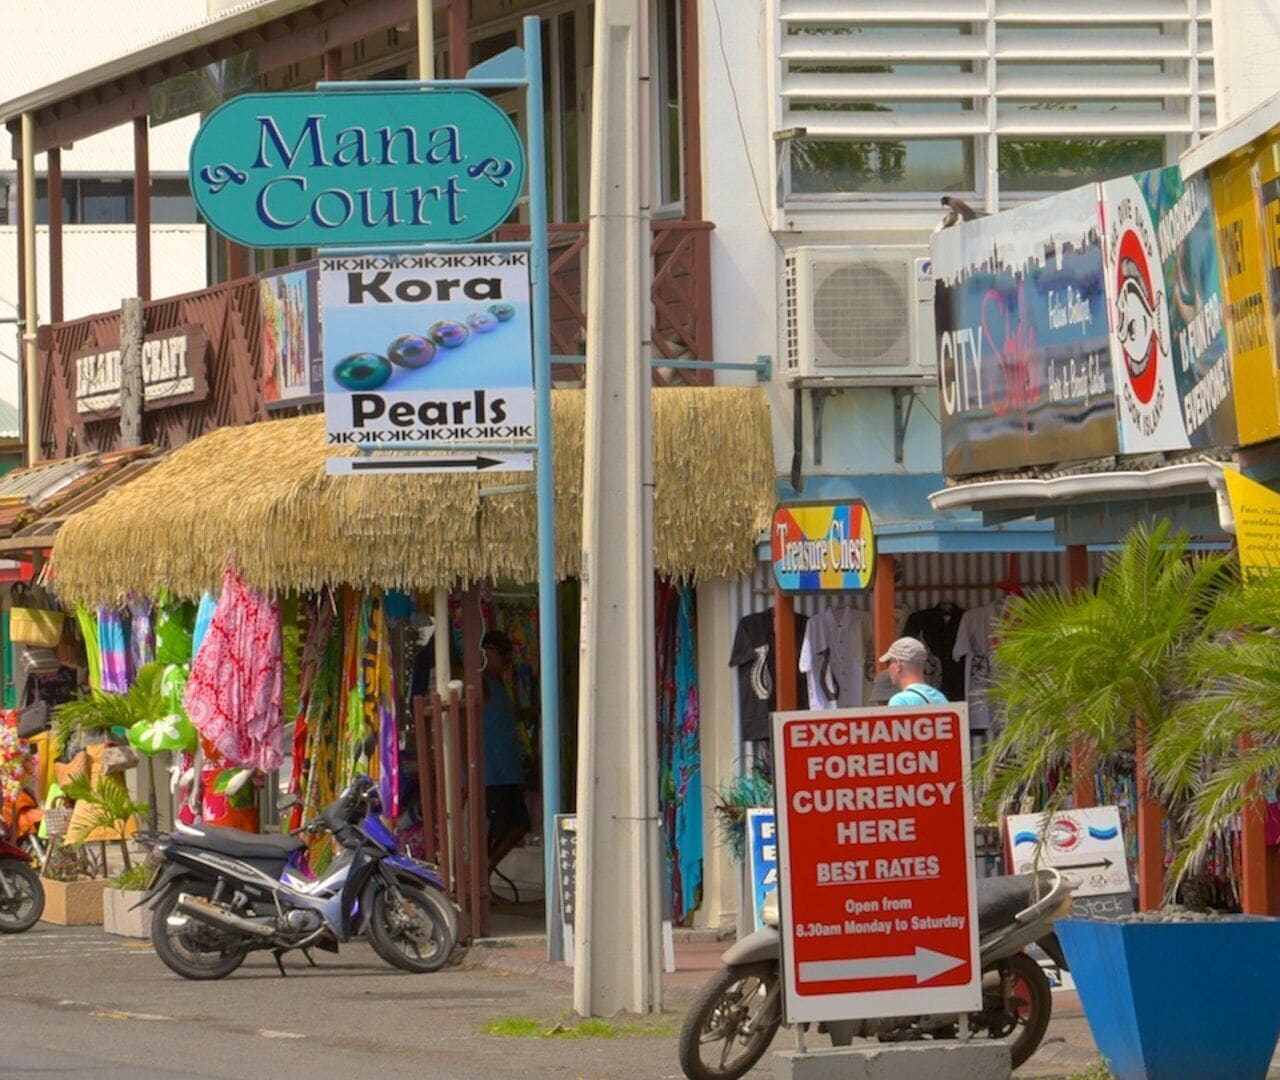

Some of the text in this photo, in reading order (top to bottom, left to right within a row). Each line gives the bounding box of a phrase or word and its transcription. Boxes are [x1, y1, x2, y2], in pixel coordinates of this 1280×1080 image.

[251, 114, 468, 171] Mana
[255, 175, 468, 230] Court
[347, 270, 505, 304] Kora
[940, 326, 984, 416] CITY
[351, 390, 507, 428] Pearls
[776, 519, 867, 573] Treasure Chest
[1245, 531, 1274, 541] money
[790, 717, 954, 748] EXCHANGE
[807, 751, 939, 780] FOREIGN
[792, 782, 956, 814] CURRENCY
[837, 818, 917, 845] HERE
[816, 855, 940, 883] BEST RATES
[845, 896, 912, 915] Open from
[1073, 896, 1122, 916] Stock
[796, 914, 966, 938] 8.30am Monday to Saturday
